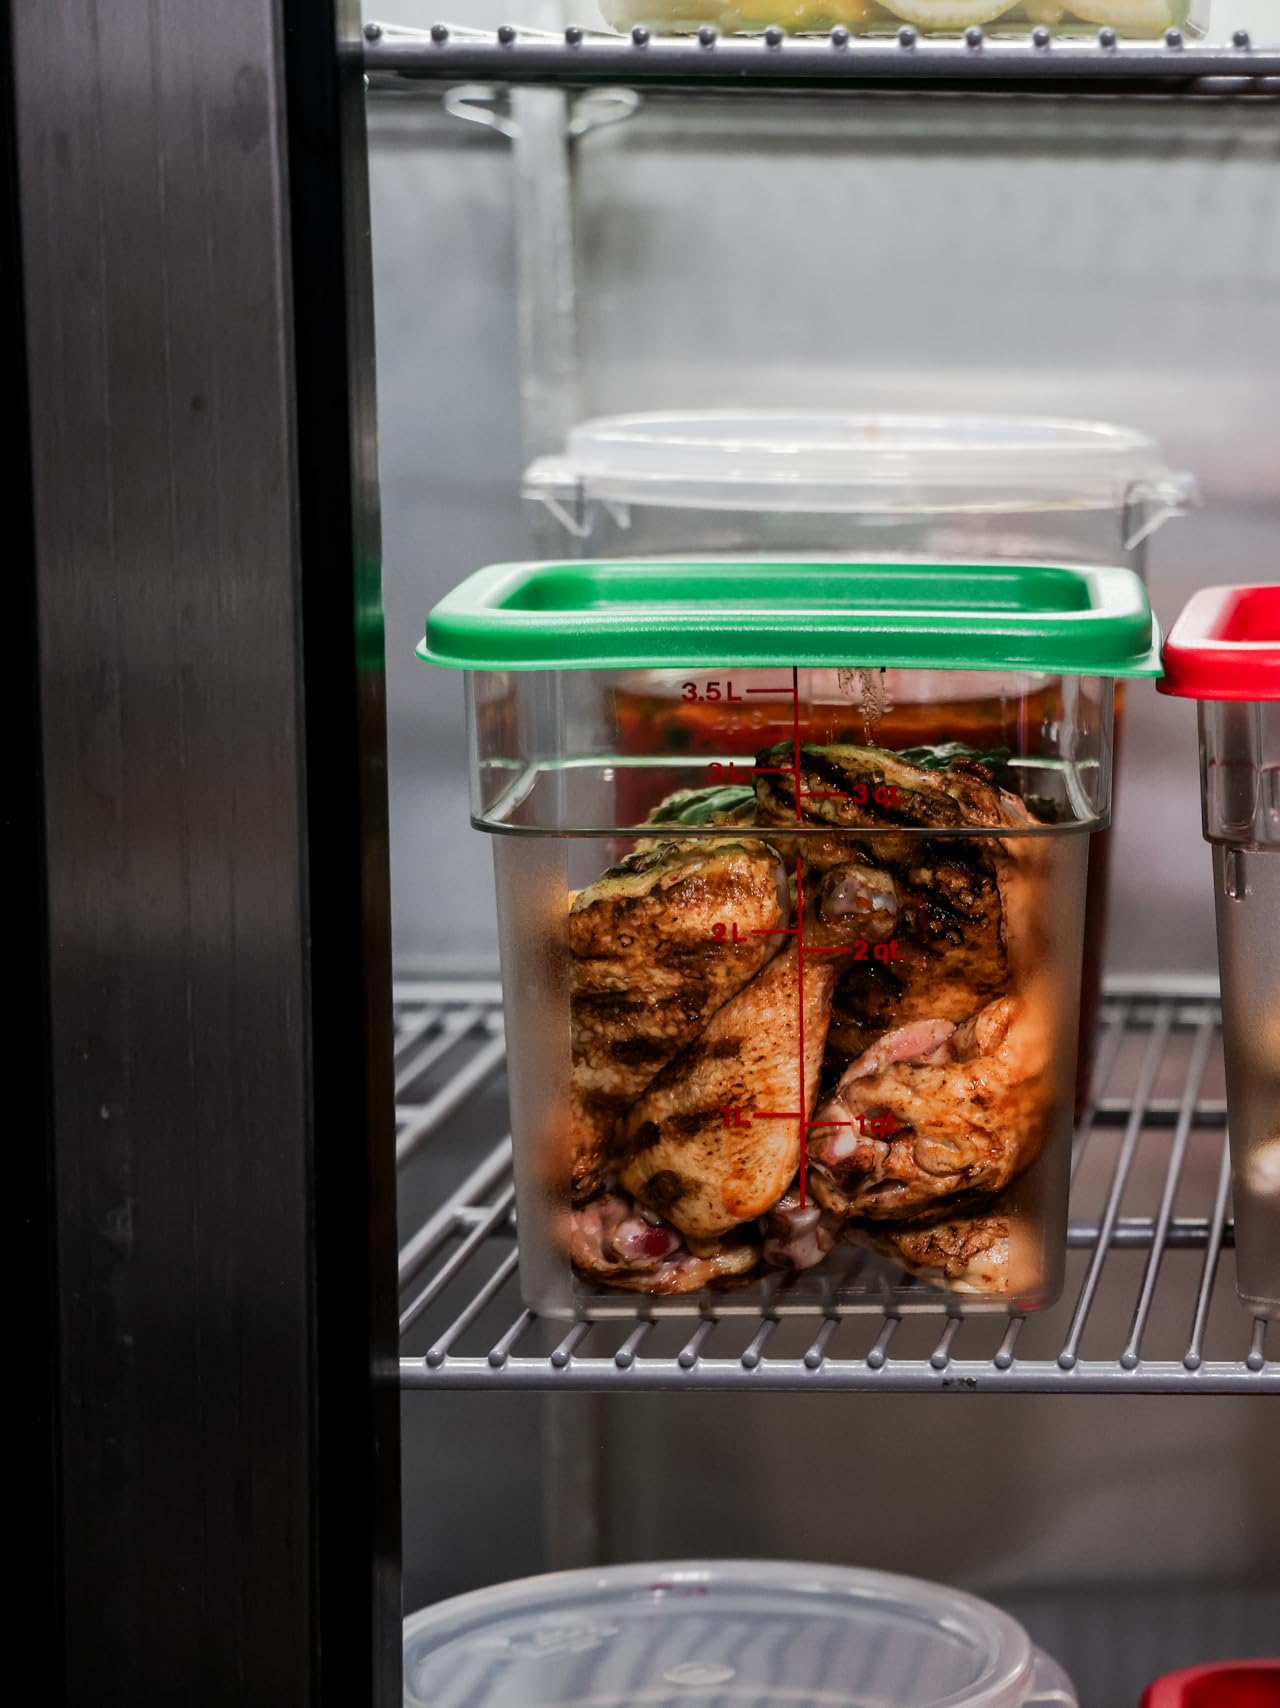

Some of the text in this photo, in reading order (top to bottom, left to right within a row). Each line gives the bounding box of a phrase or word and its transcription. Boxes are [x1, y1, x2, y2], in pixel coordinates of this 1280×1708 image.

[682, 681, 743, 703] 3.5 L
[729, 762, 745, 783] L
[852, 784, 869, 805] 3
[712, 922, 748, 943] 2 L
[853, 939, 869, 961] 2
[855, 1113, 866, 1135] 1
